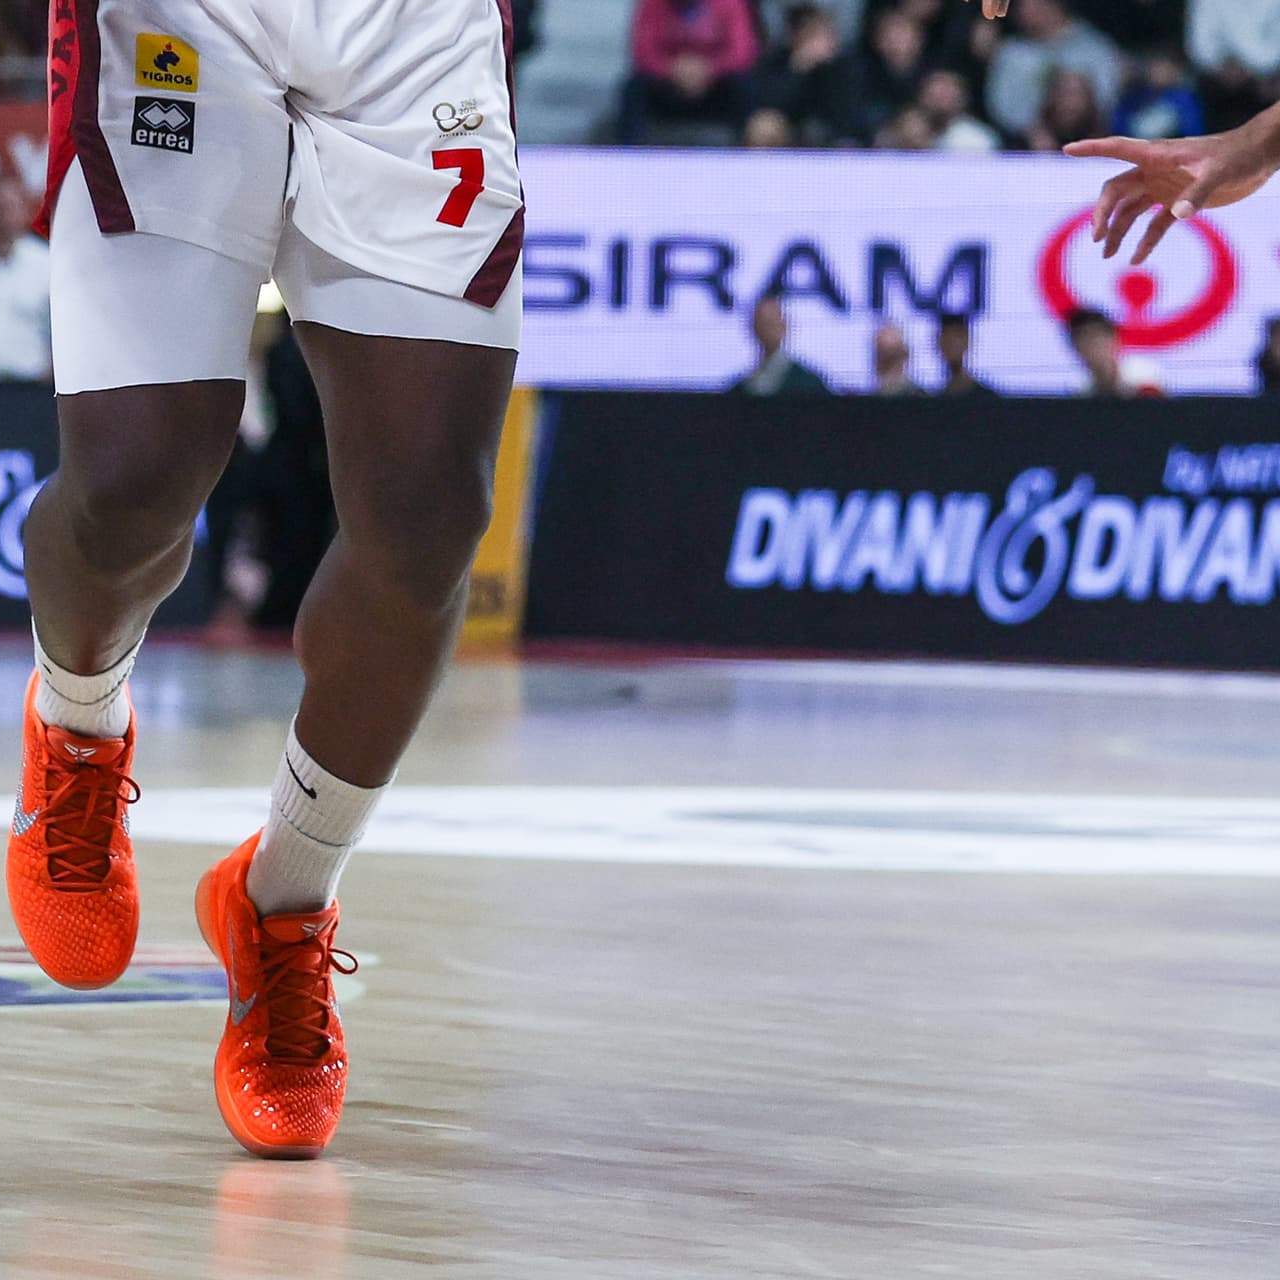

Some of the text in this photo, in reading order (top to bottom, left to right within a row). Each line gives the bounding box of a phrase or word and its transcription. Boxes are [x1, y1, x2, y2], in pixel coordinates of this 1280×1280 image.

[141, 70, 193, 86] TIGROS
[431, 148, 486, 228] 7
[520, 233, 990, 316] SIRAM
[724, 486, 992, 591] DIVANI
